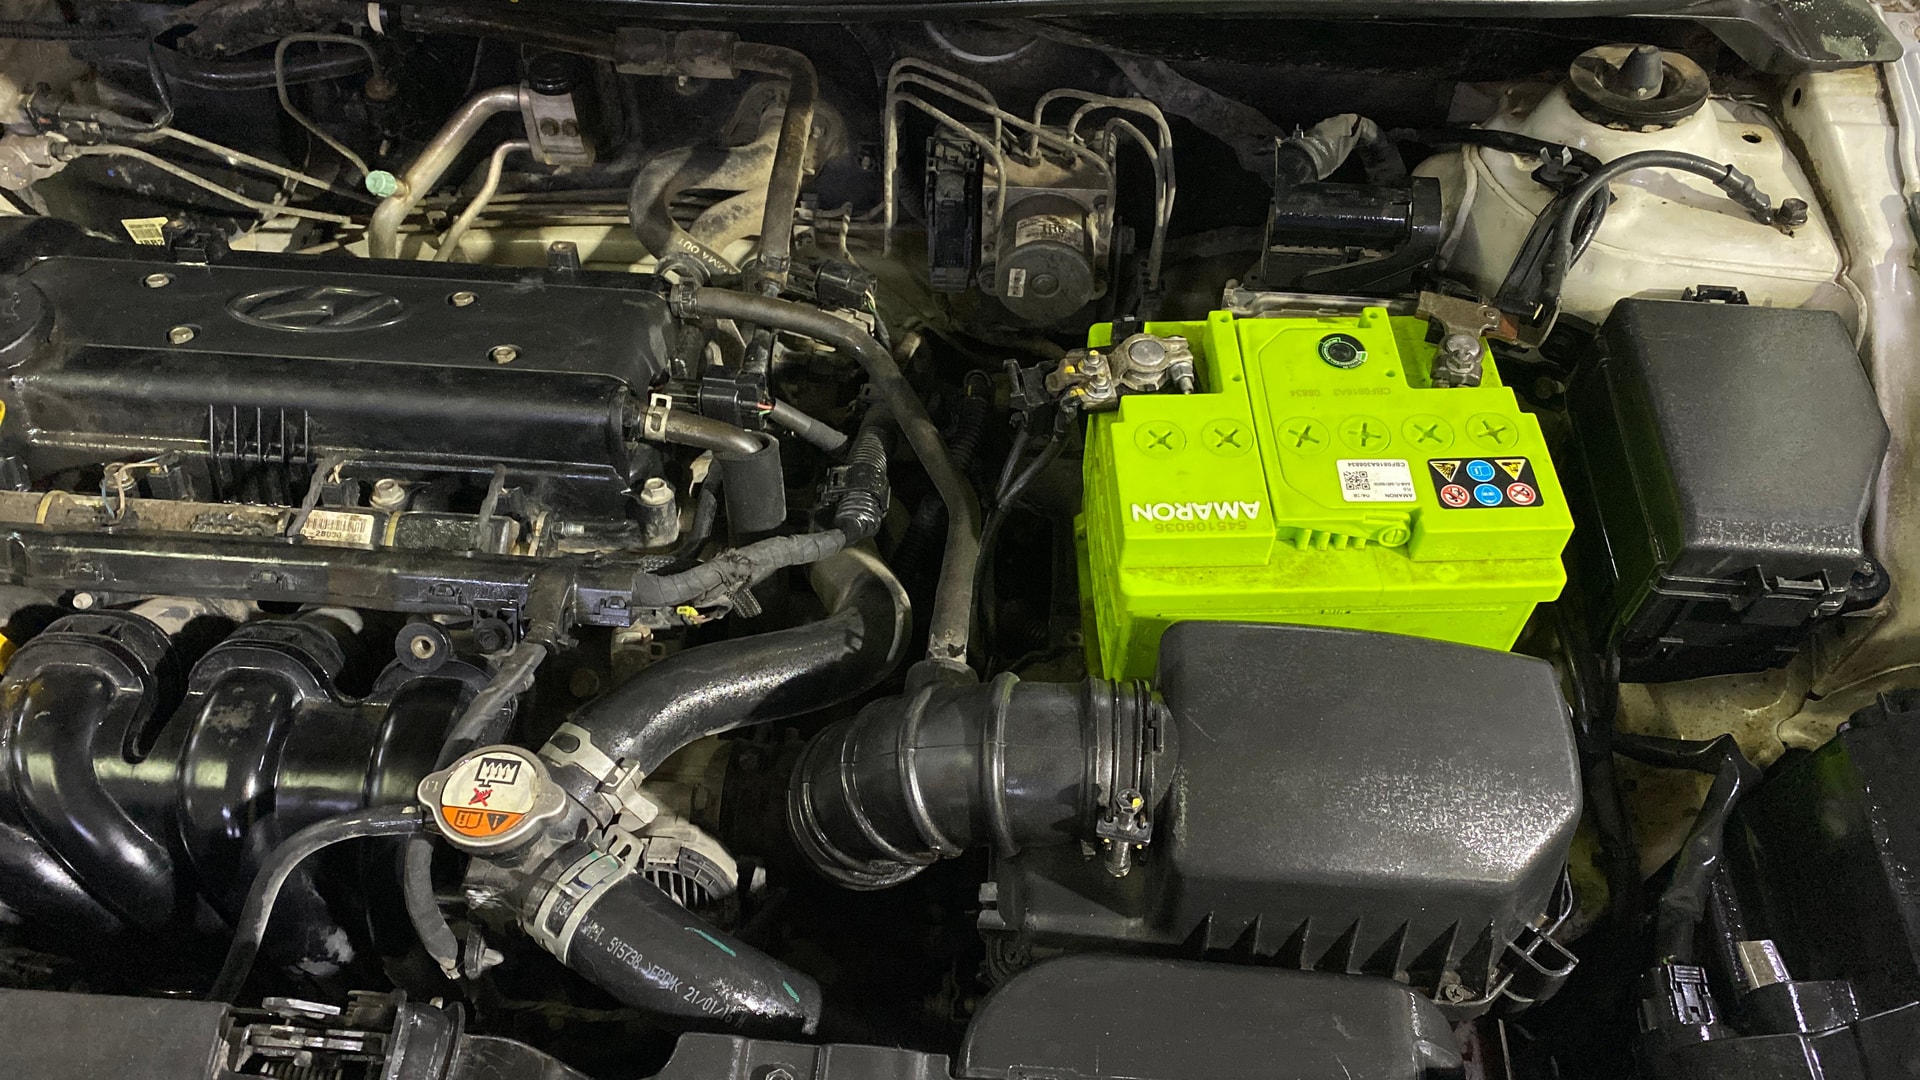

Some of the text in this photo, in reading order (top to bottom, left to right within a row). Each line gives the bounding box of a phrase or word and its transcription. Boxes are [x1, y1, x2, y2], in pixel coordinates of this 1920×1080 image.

[677, 238, 700, 254] OUT
[1131, 500, 1260, 522] AMARON
[1154, 520, 1248, 533] 545106036
